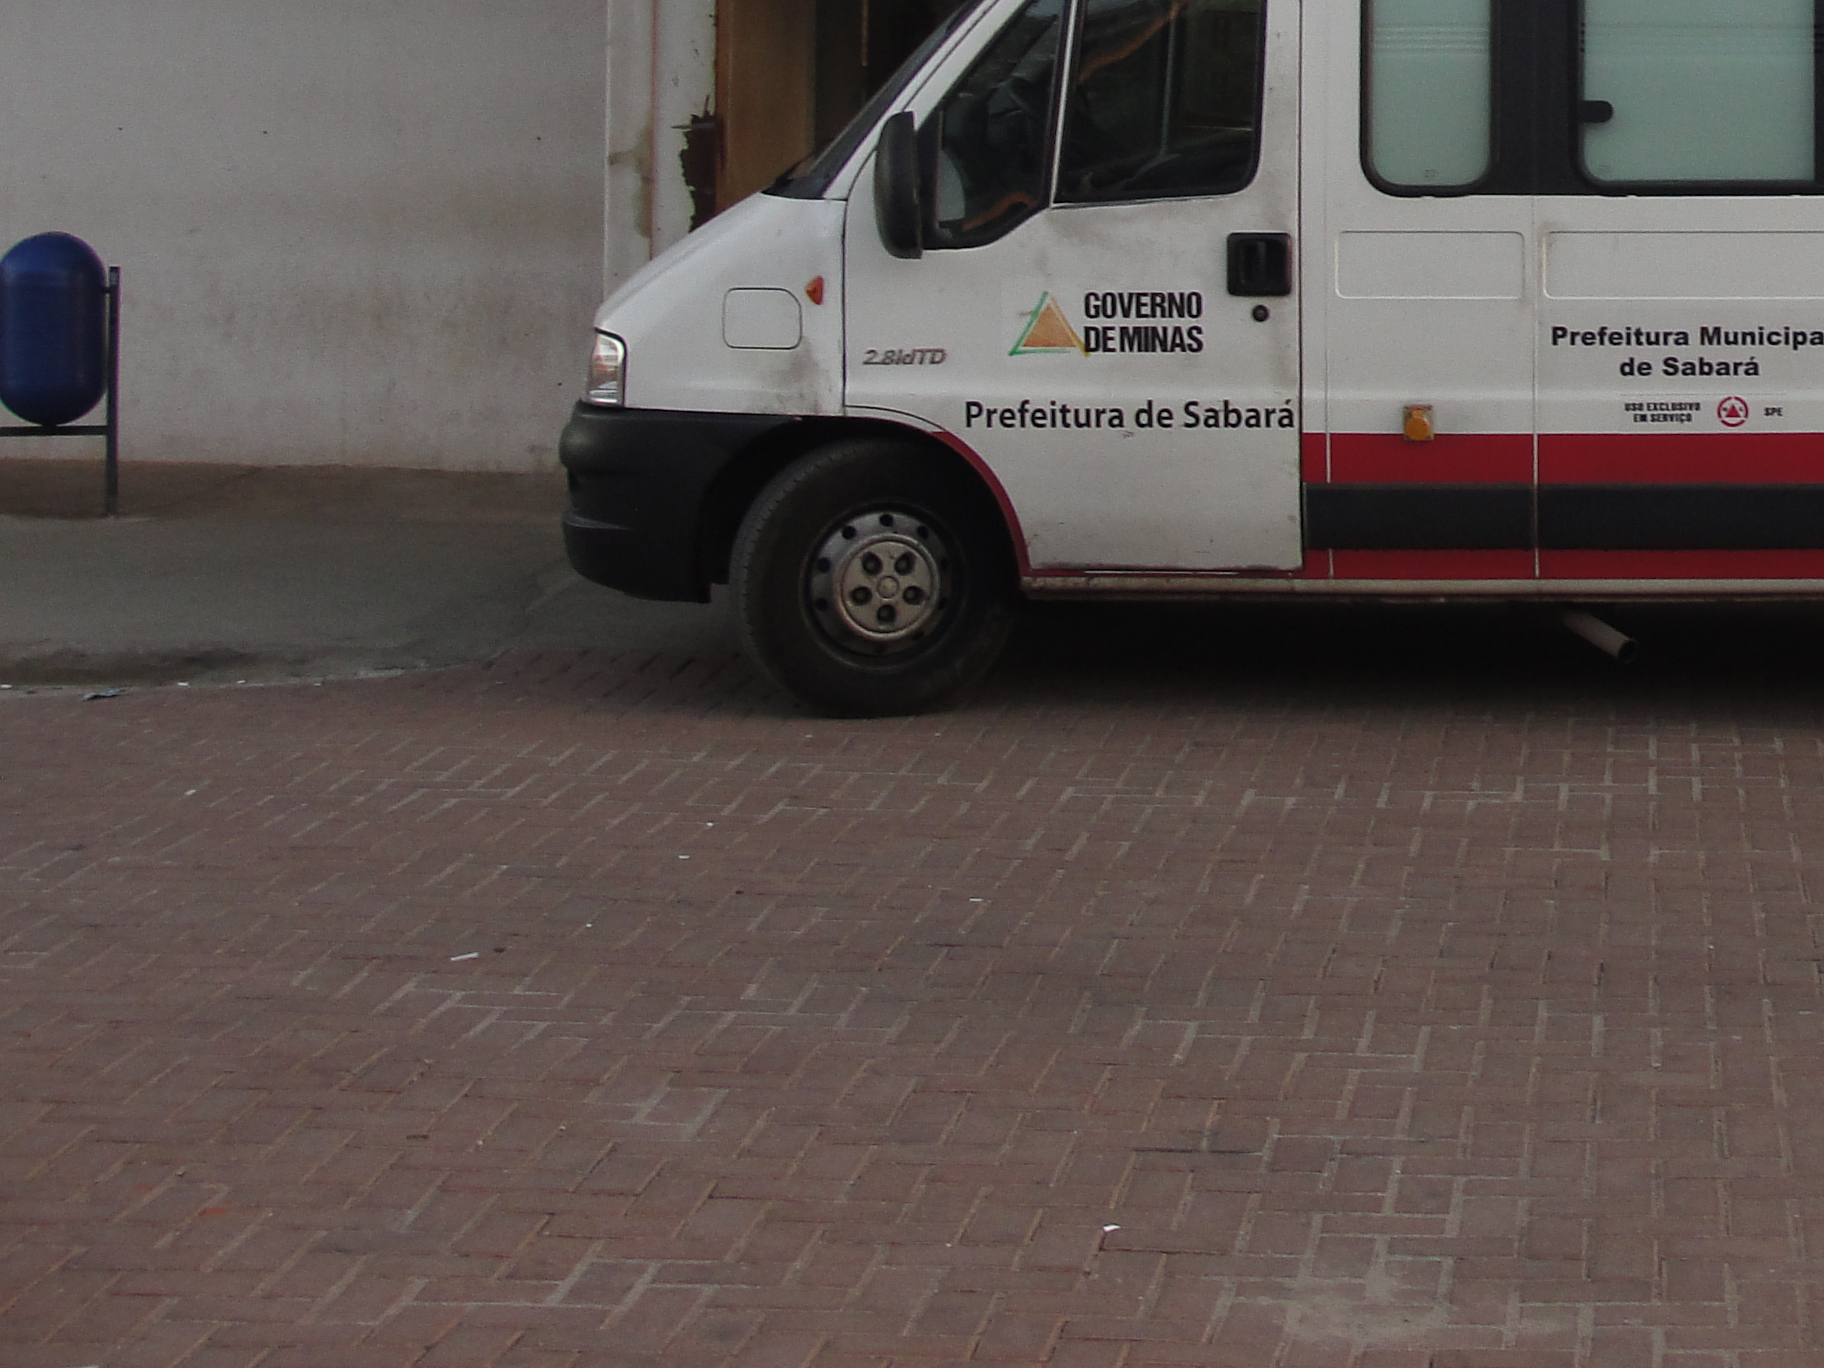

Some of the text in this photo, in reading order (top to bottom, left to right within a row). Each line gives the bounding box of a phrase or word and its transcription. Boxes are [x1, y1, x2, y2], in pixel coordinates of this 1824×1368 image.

[1084, 291, 1203, 320] GOVERNO
[1083, 324, 1205, 353] DE MINAS
[1551, 325, 1690, 346] Prefeitura
[1620, 356, 1760, 377] de Sabará
[966, 400, 1296, 429] Prefeitura de Sabará
[1624, 402, 1701, 412] USO EXCLUSIVO
[1633, 413, 1648, 423] EM
